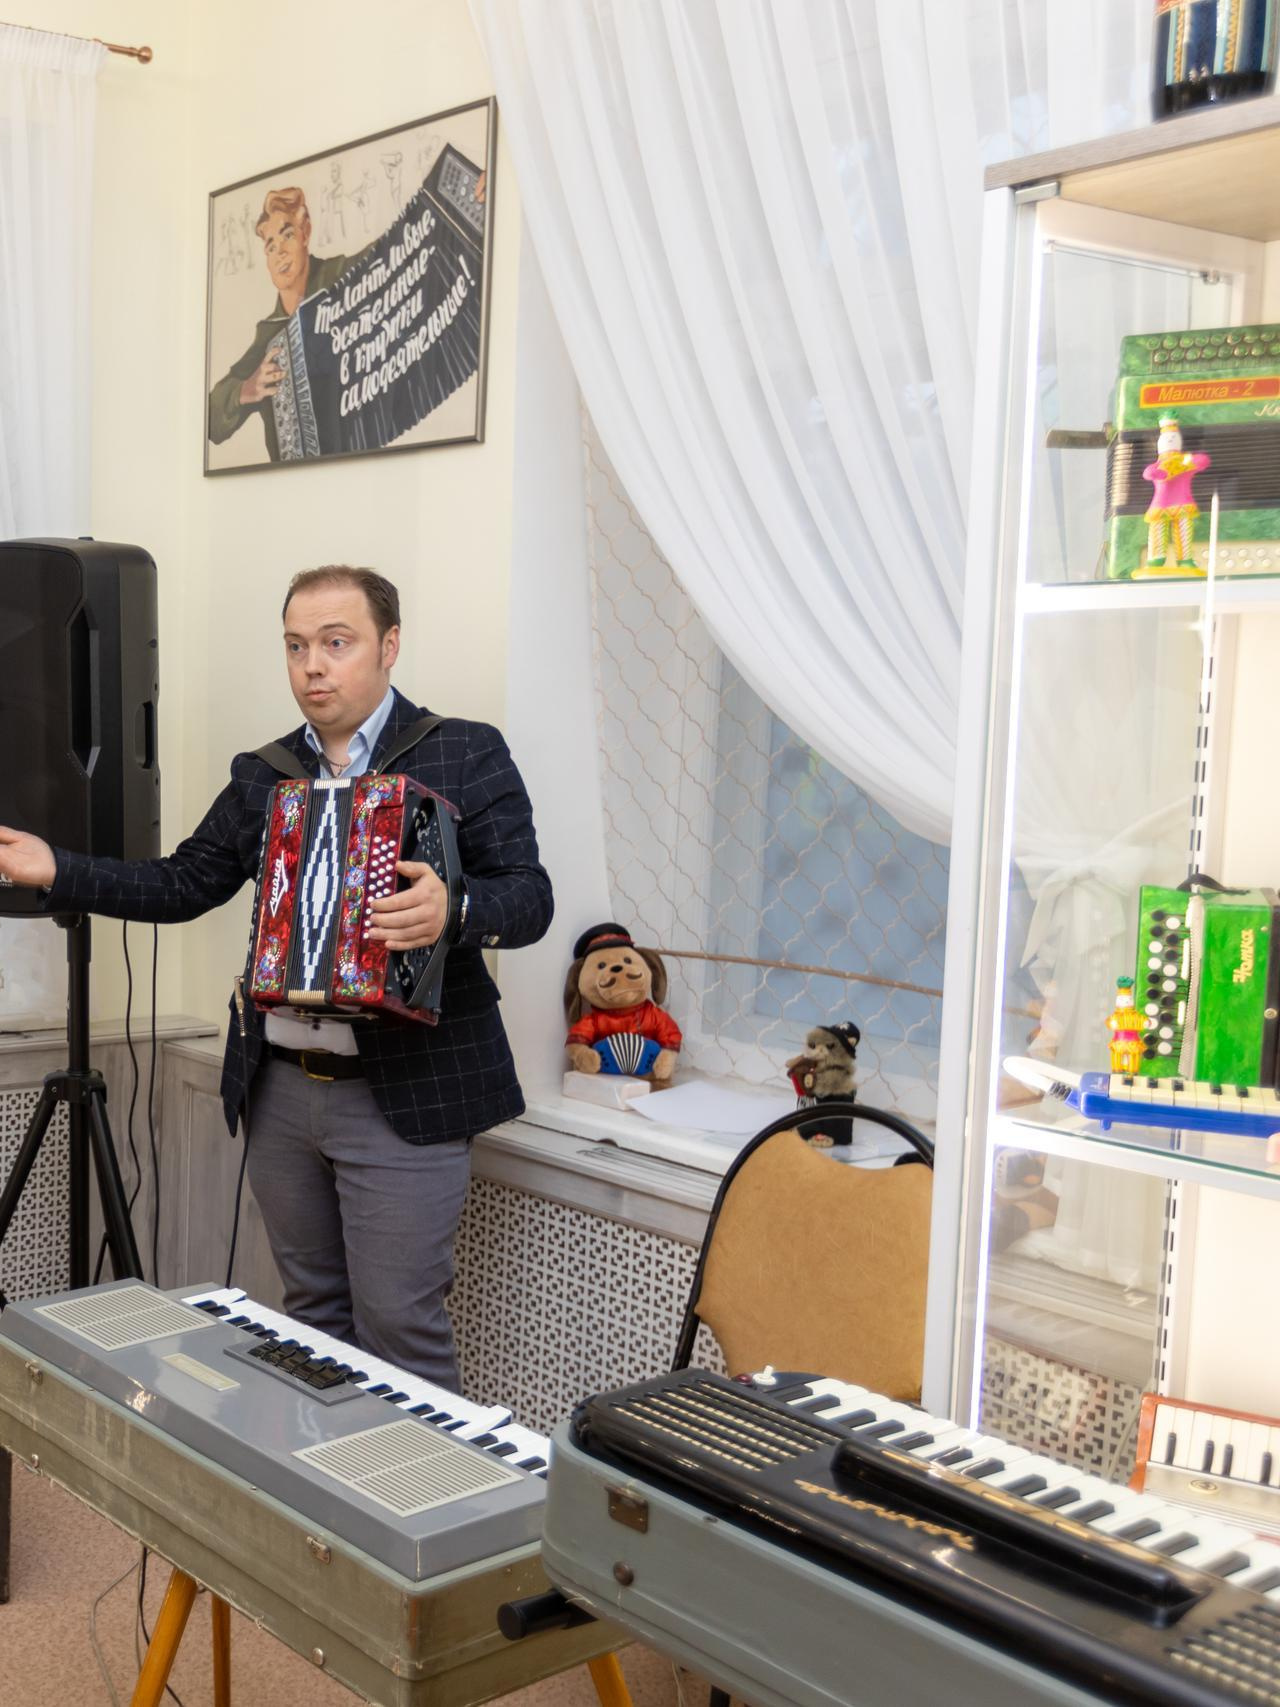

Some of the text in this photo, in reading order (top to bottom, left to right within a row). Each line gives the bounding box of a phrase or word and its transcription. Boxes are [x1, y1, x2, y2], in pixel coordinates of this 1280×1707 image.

[314, 209, 435, 334] талантливые,
[340, 289, 424, 385] в кружки
[1158, 385, 1230, 402] Малютка
[1242, 381, 1256, 397] 2
